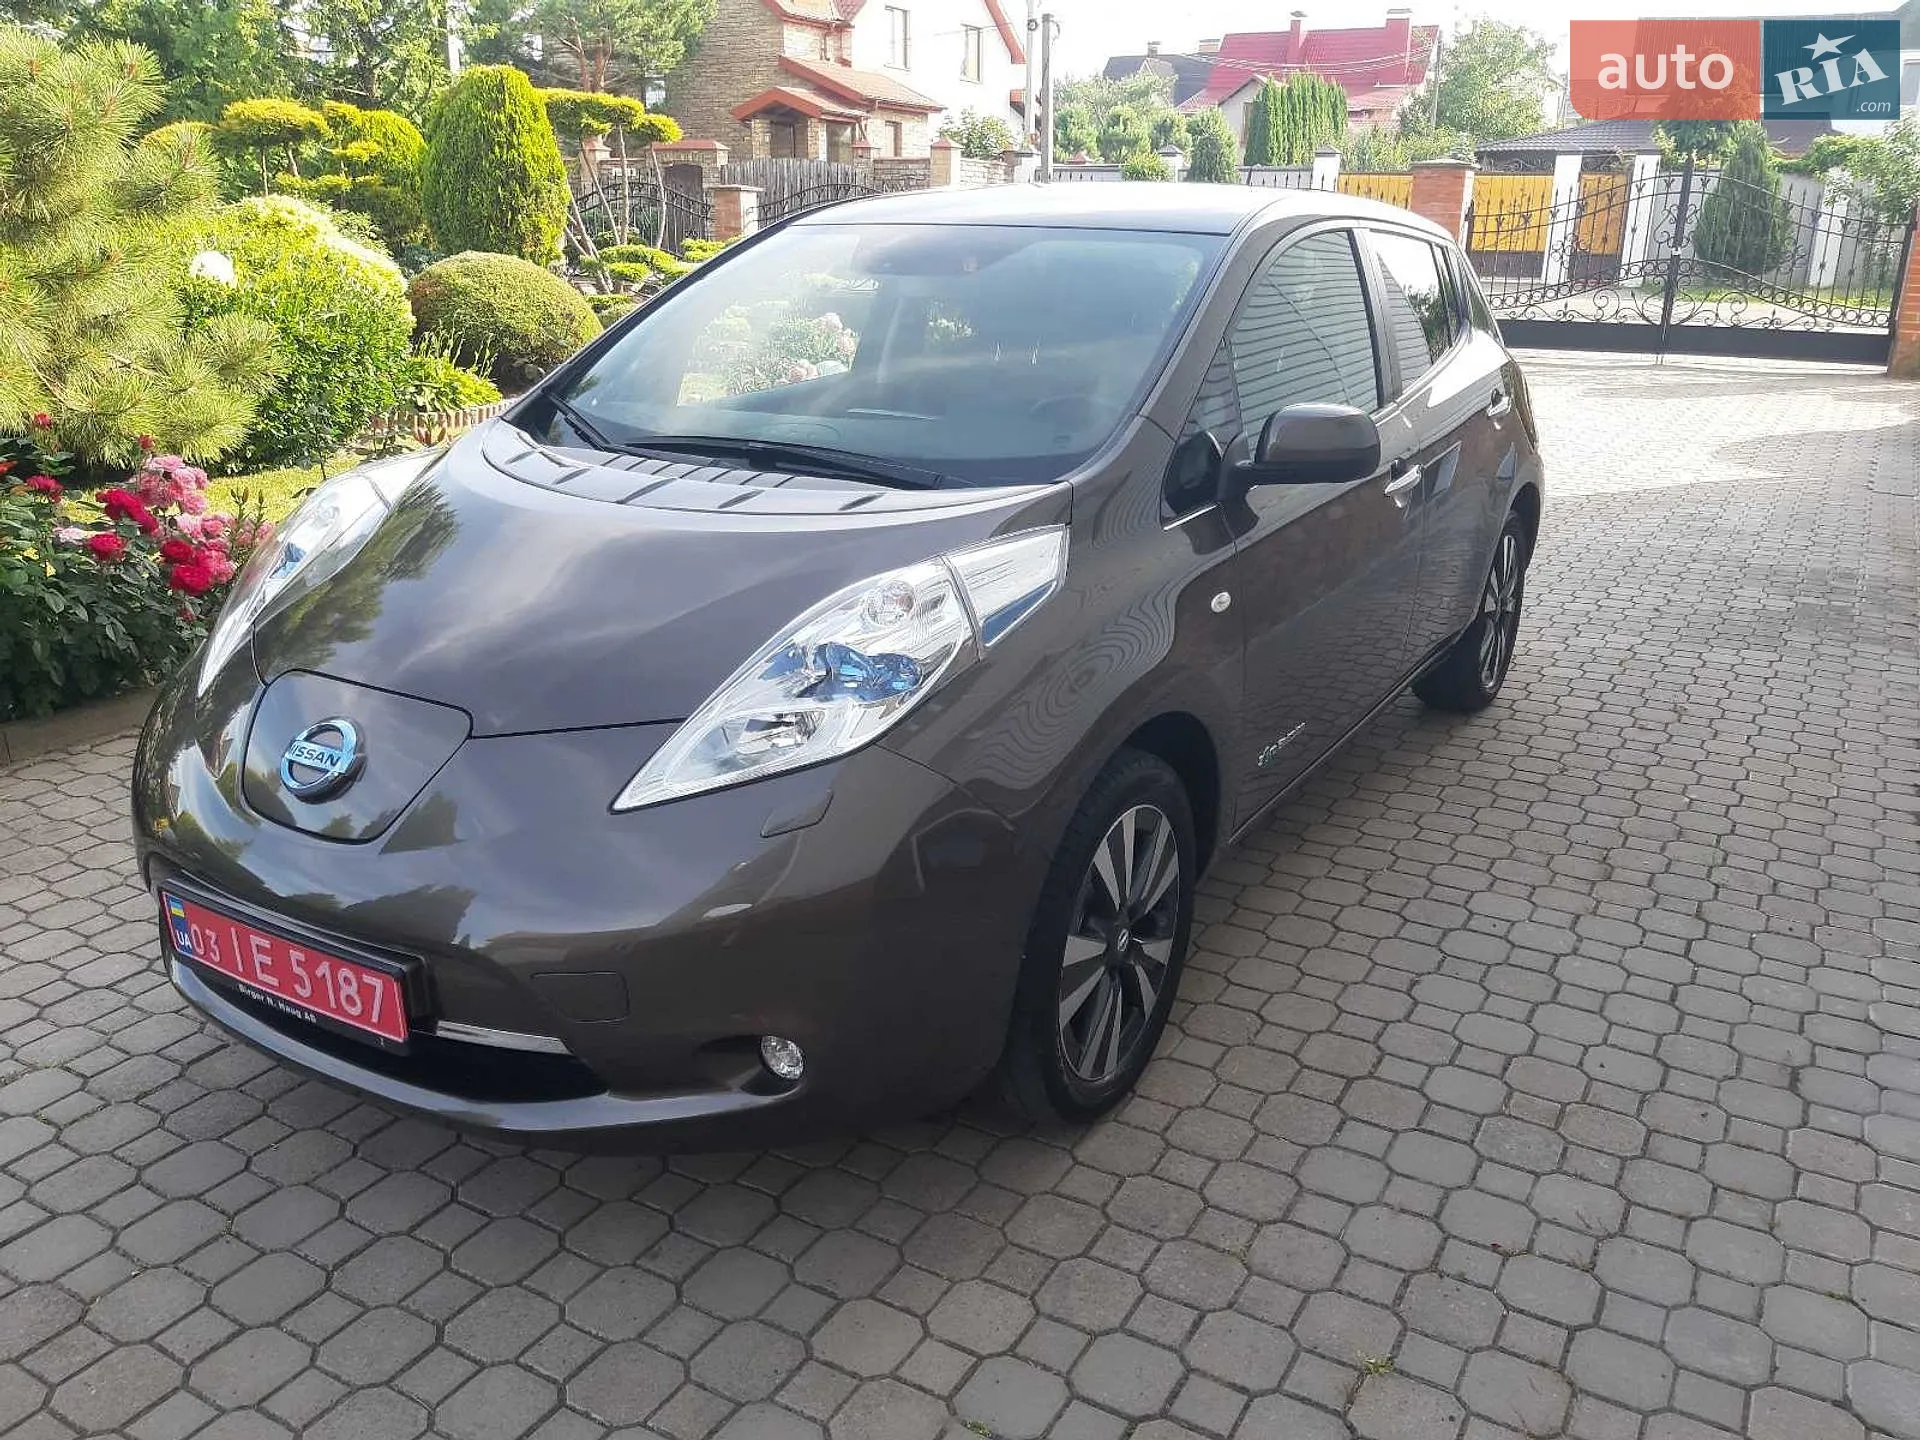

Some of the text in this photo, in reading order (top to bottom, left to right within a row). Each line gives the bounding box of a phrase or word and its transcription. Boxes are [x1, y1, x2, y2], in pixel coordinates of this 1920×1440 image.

[175, 929, 192, 950] UA
[190, 923, 383, 1024] 03 IE 5187
